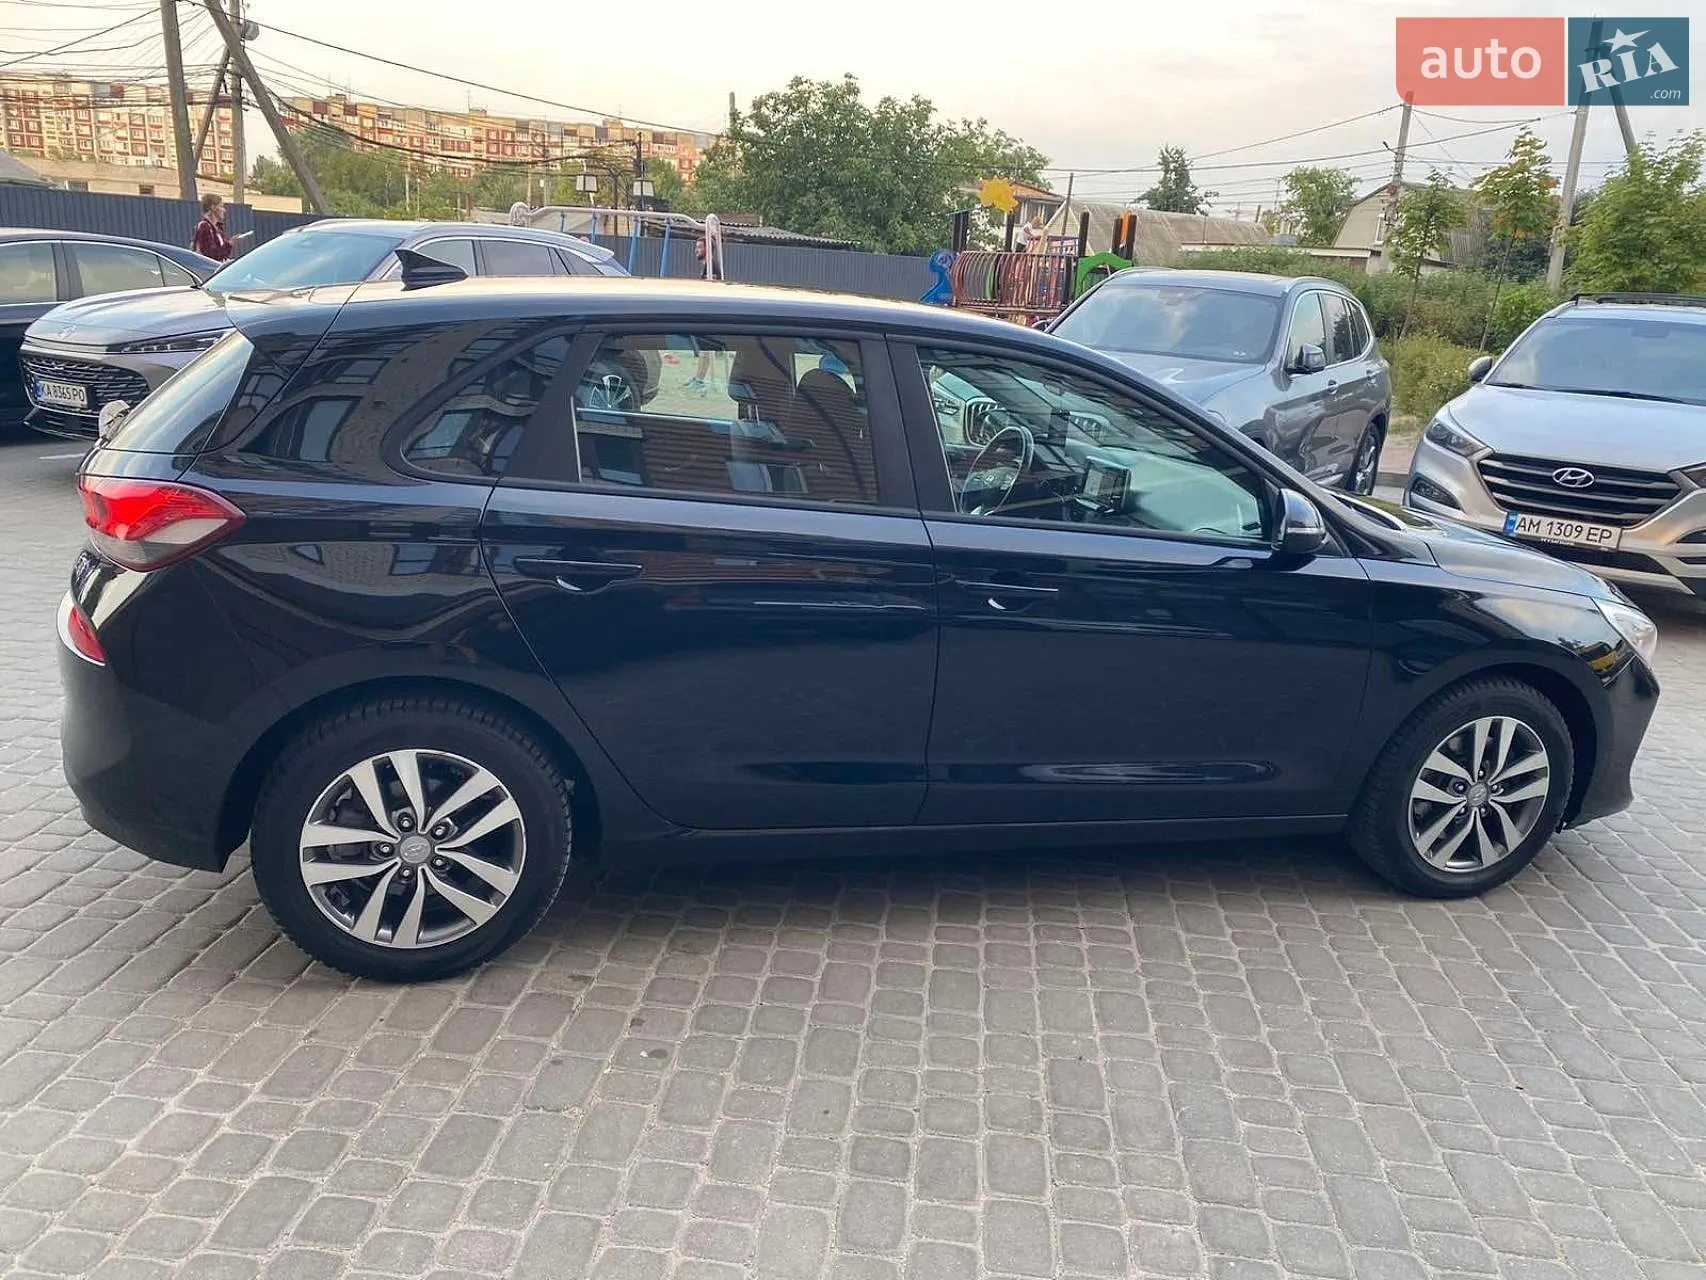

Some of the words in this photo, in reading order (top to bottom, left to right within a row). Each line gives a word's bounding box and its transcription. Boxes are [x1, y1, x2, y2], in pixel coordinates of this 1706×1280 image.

[1516, 517, 1541, 533] AM
[1546, 521, 1583, 539] 1309
[1586, 527, 1612, 543] EP
